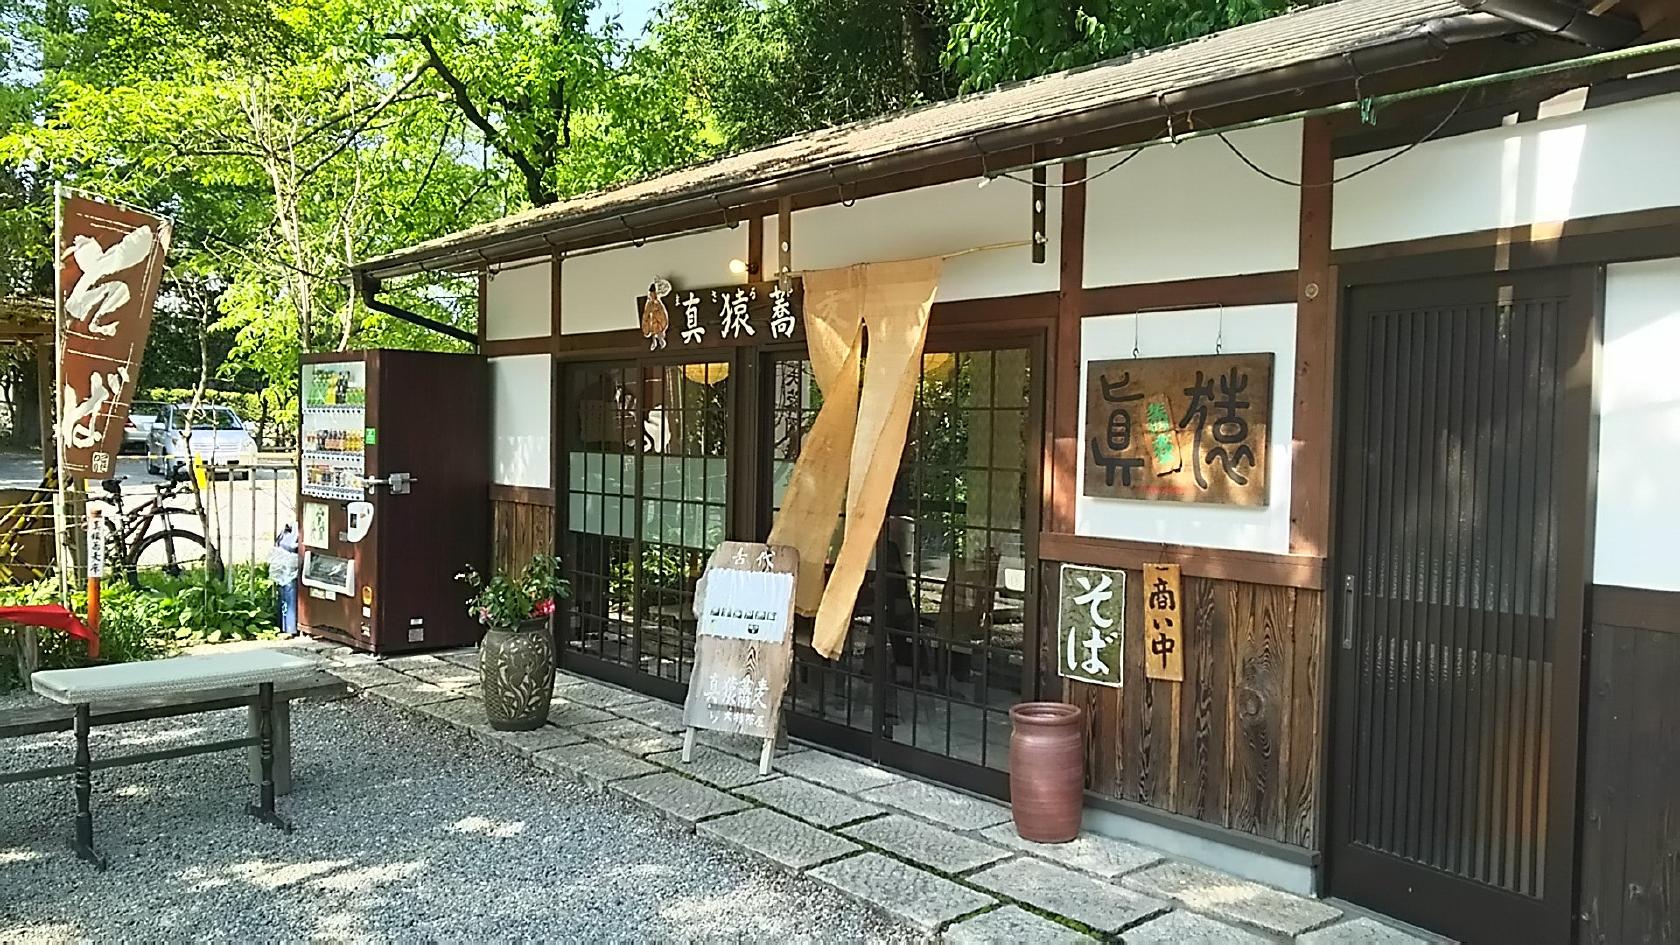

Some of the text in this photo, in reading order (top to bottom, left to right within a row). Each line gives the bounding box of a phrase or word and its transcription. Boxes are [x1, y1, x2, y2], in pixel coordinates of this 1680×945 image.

[1066, 573, 1119, 676] そば
[1148, 577, 1177, 673] 商い中
